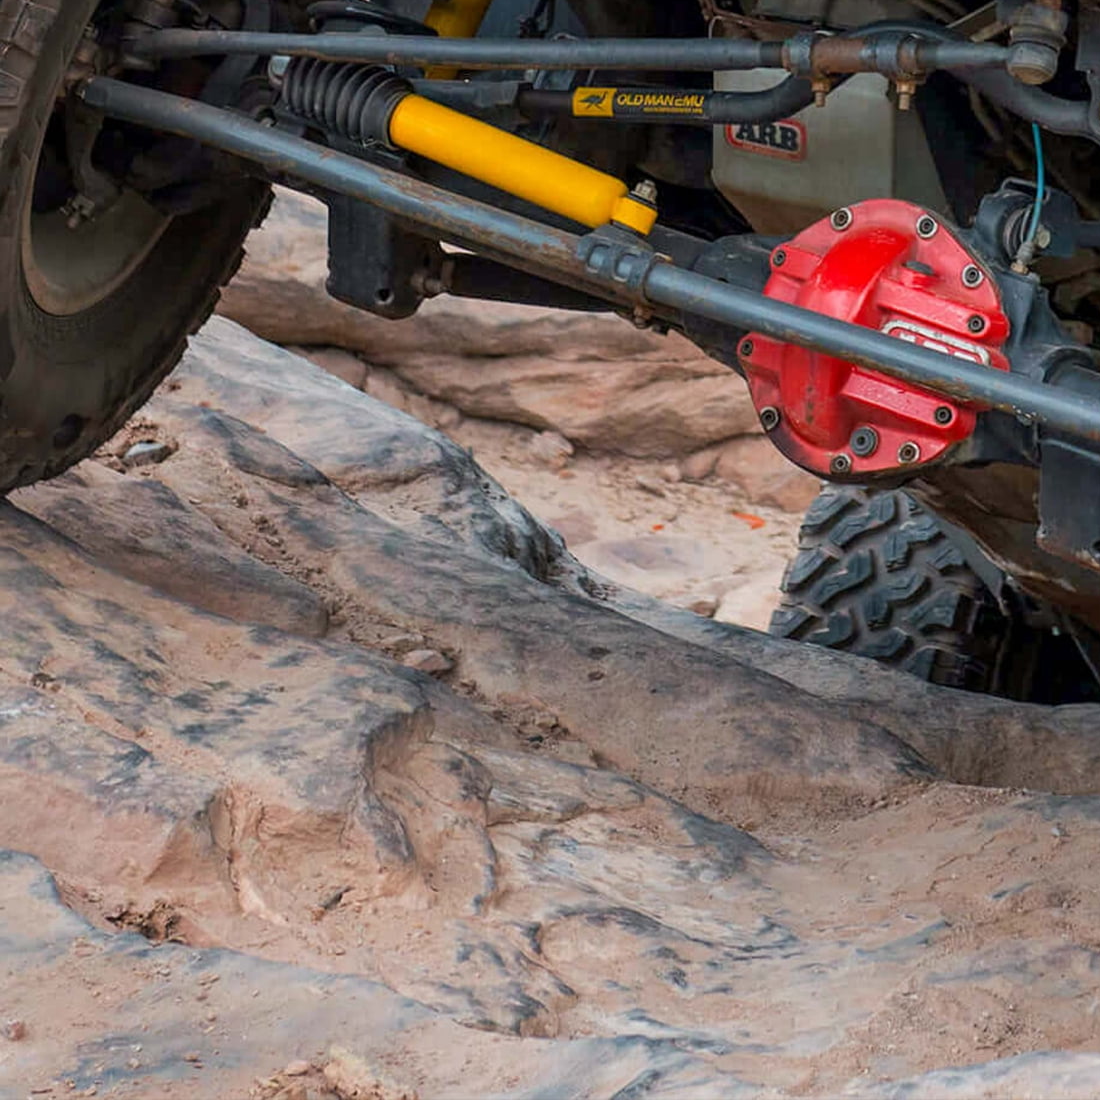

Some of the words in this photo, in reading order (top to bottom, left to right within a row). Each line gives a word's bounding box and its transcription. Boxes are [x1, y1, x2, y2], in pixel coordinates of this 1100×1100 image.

[617, 94, 643, 106] OLD
[643, 94, 675, 106] MAN
[736, 123, 798, 151] ARB
